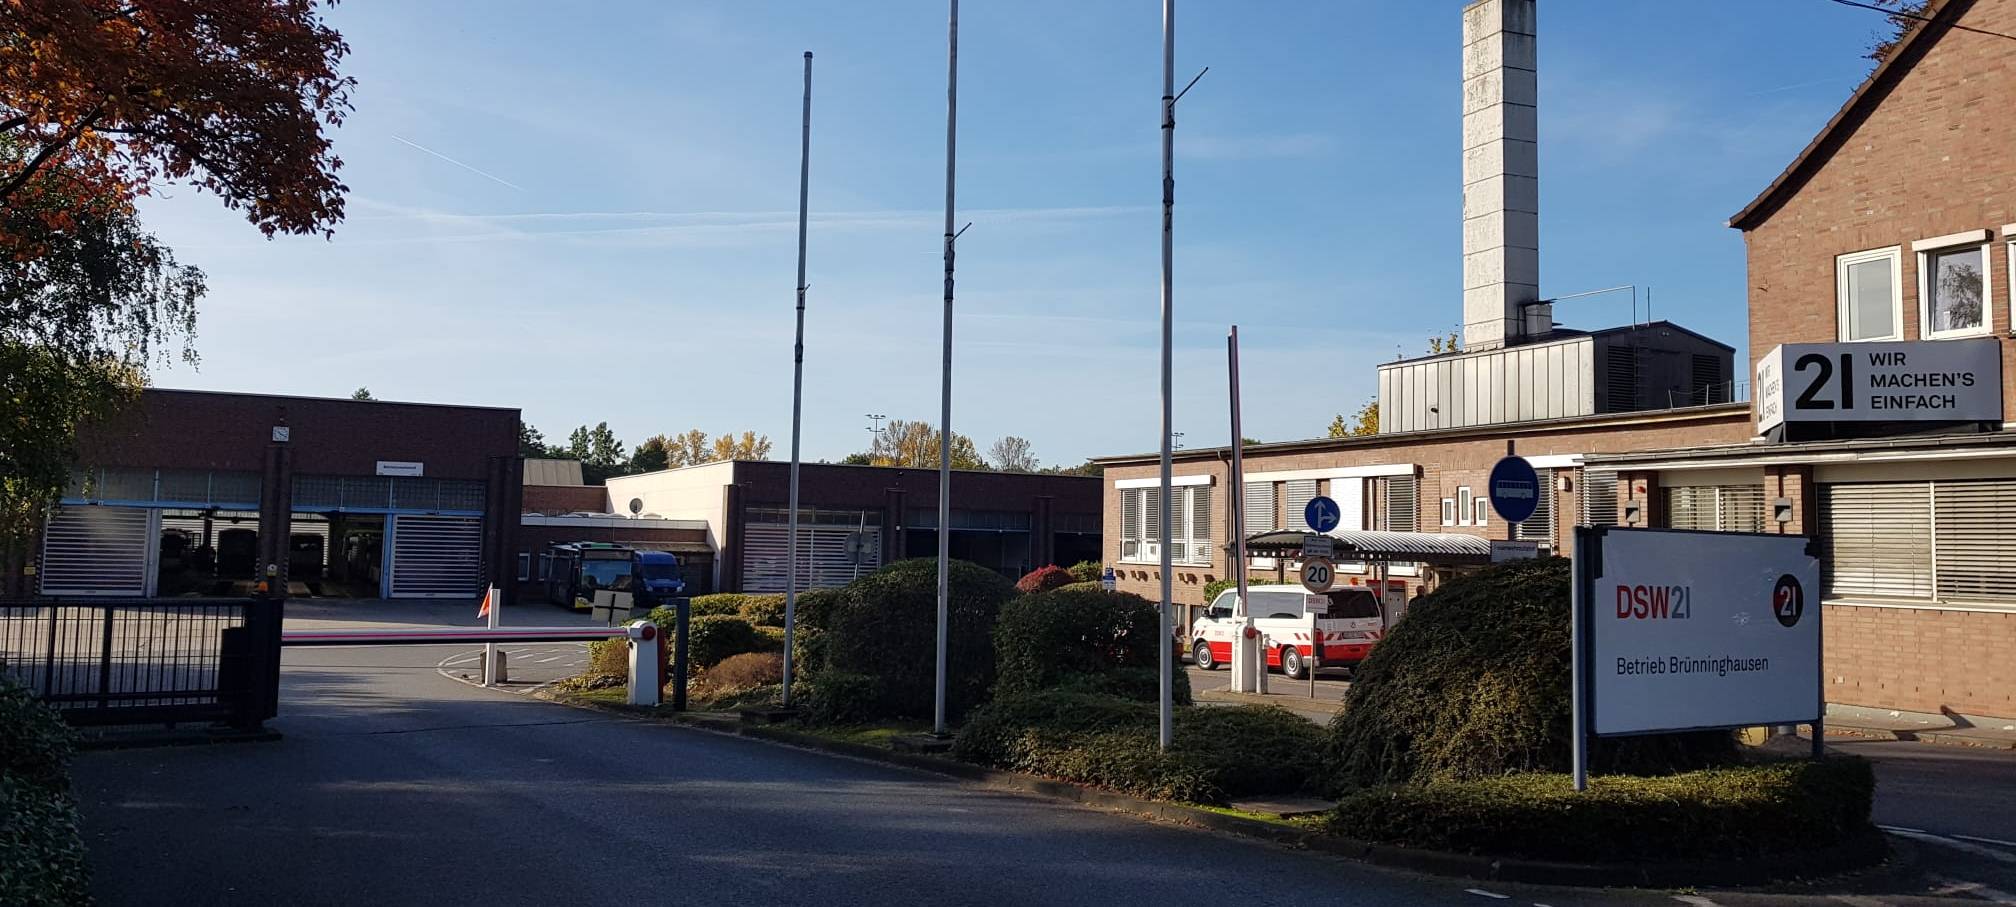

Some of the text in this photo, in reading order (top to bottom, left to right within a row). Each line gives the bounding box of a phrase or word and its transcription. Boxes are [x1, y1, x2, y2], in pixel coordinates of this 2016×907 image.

[1869, 352, 1906, 366] WIR
[1794, 353, 1854, 409] 21
[1870, 372, 1975, 388] MACHEN'S
[1871, 394, 1956, 409] EINFACH
[1308, 566, 1328, 583] 20
[1617, 585, 1691, 619] DSW21
[1780, 585, 1797, 617] 21
[1617, 655, 1769, 677] Betrieb Brünninghausen
